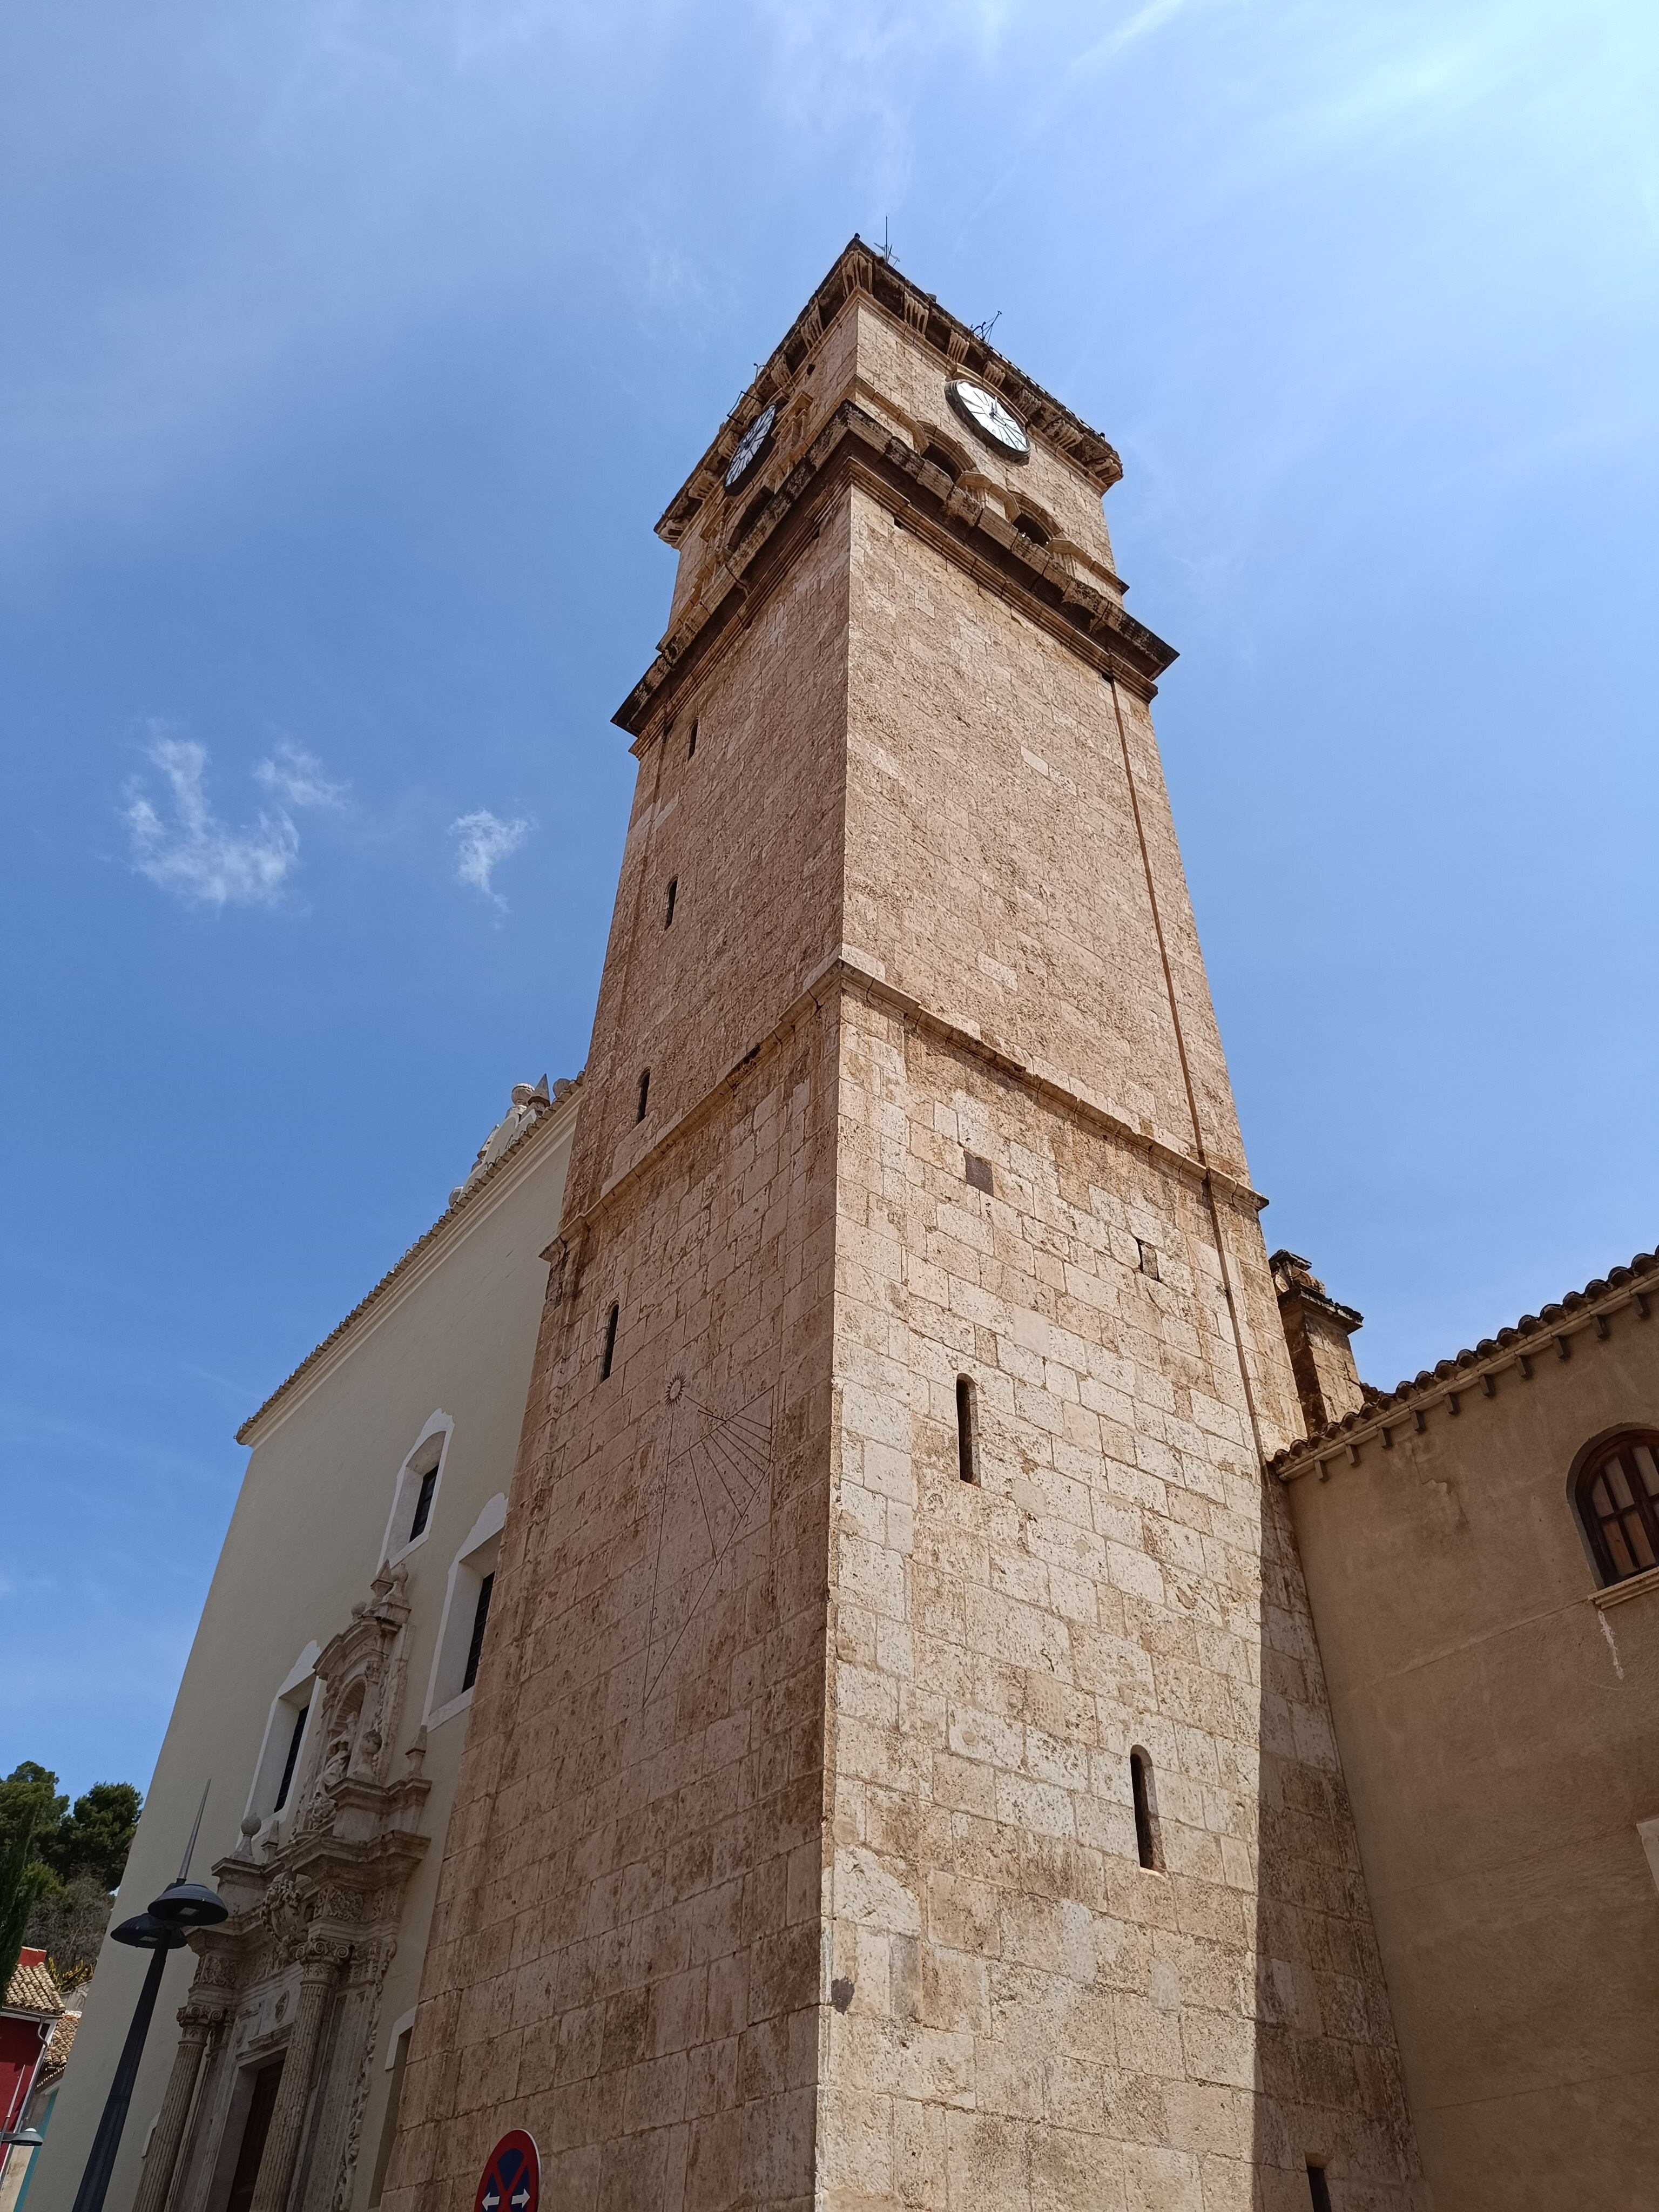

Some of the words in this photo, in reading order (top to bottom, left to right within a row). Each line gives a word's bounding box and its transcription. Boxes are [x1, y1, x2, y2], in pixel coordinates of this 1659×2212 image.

[764, 1472, 770, 1487] 4
[756, 1491, 761, 1506] 3
[743, 1514, 752, 1528] 2
[719, 1560, 723, 1576] 1
[649, 1607, 658, 1624] 12
